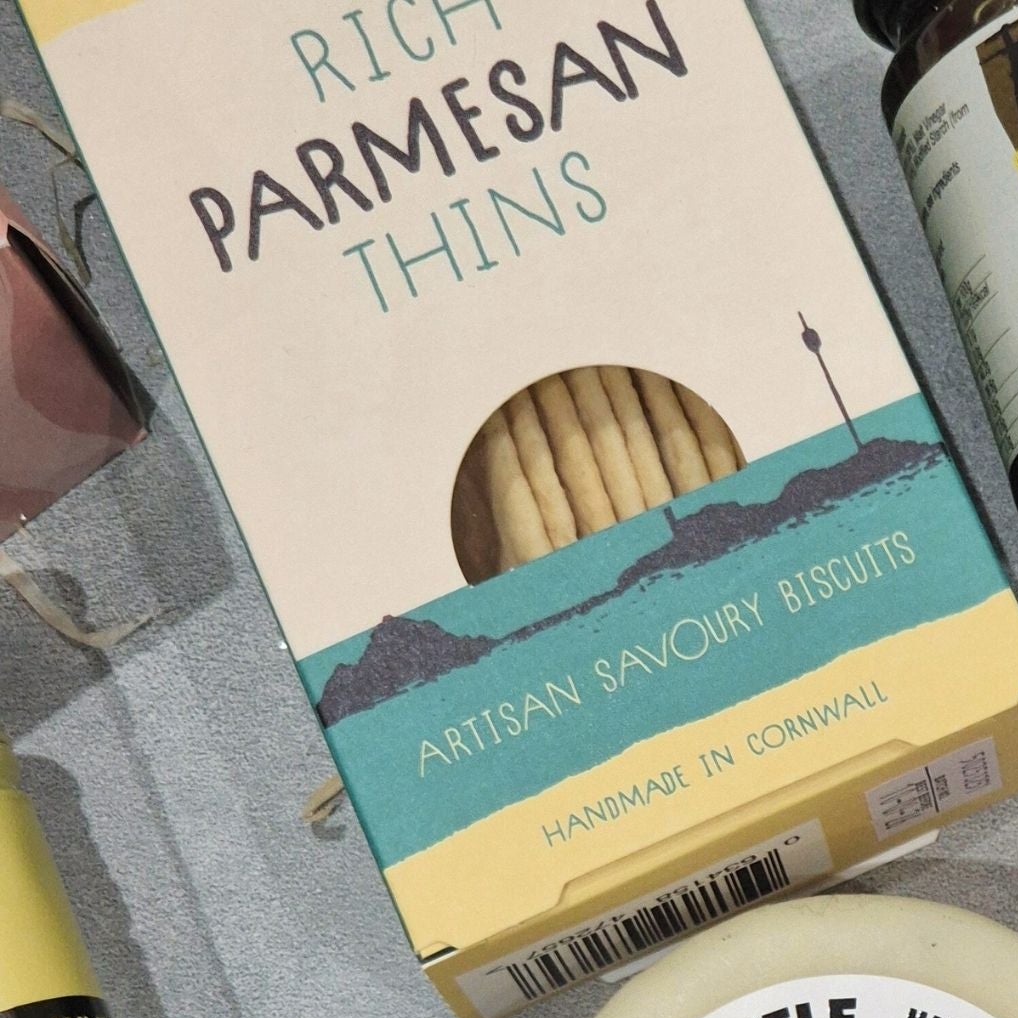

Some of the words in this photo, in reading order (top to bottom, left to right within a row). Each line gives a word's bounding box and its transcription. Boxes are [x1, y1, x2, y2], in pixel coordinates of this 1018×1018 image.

[189, 0, 689, 273] PARMESAN
[343, 151, 608, 313] THINS
[417, 672, 584, 778] ARTISAN
[593, 591, 766, 694] SAVOURY
[777, 530, 916, 615] BISCUITS
[541, 763, 692, 849] HANDMADE
[699, 744, 734, 777] IN
[747, 681, 888, 757] CORNWALL
